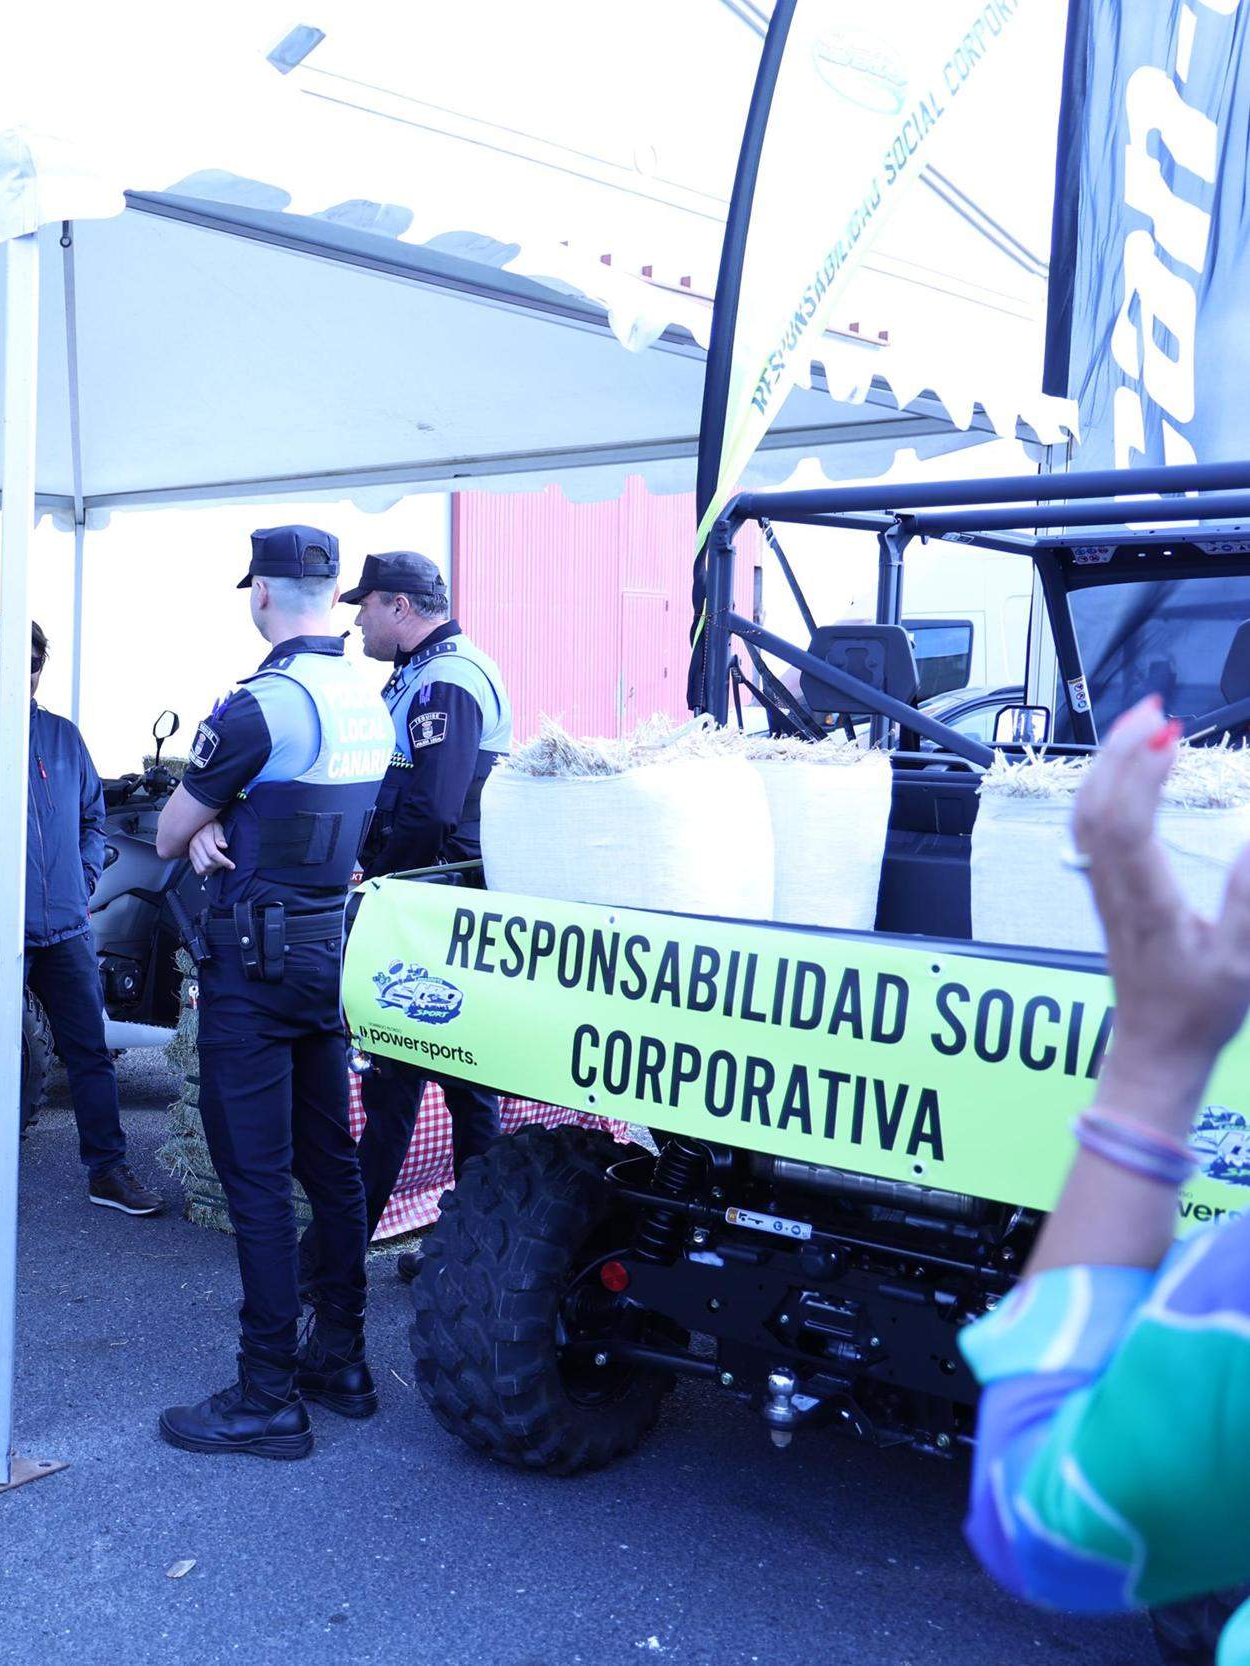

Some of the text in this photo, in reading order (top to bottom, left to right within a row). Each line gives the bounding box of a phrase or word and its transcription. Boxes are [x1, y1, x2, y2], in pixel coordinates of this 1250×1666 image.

[883, 91, 945, 185] SOCIAL
[942, 0, 1019, 96] CORPOR
[337, 717, 387, 743] LOCAL
[413, 1008, 451, 1019] SPORT
[445, 907, 910, 1045] RESPONSABILIDAD
[369, 1027, 478, 1066] powersports.
[571, 1023, 945, 1162] CORPORATIVA
